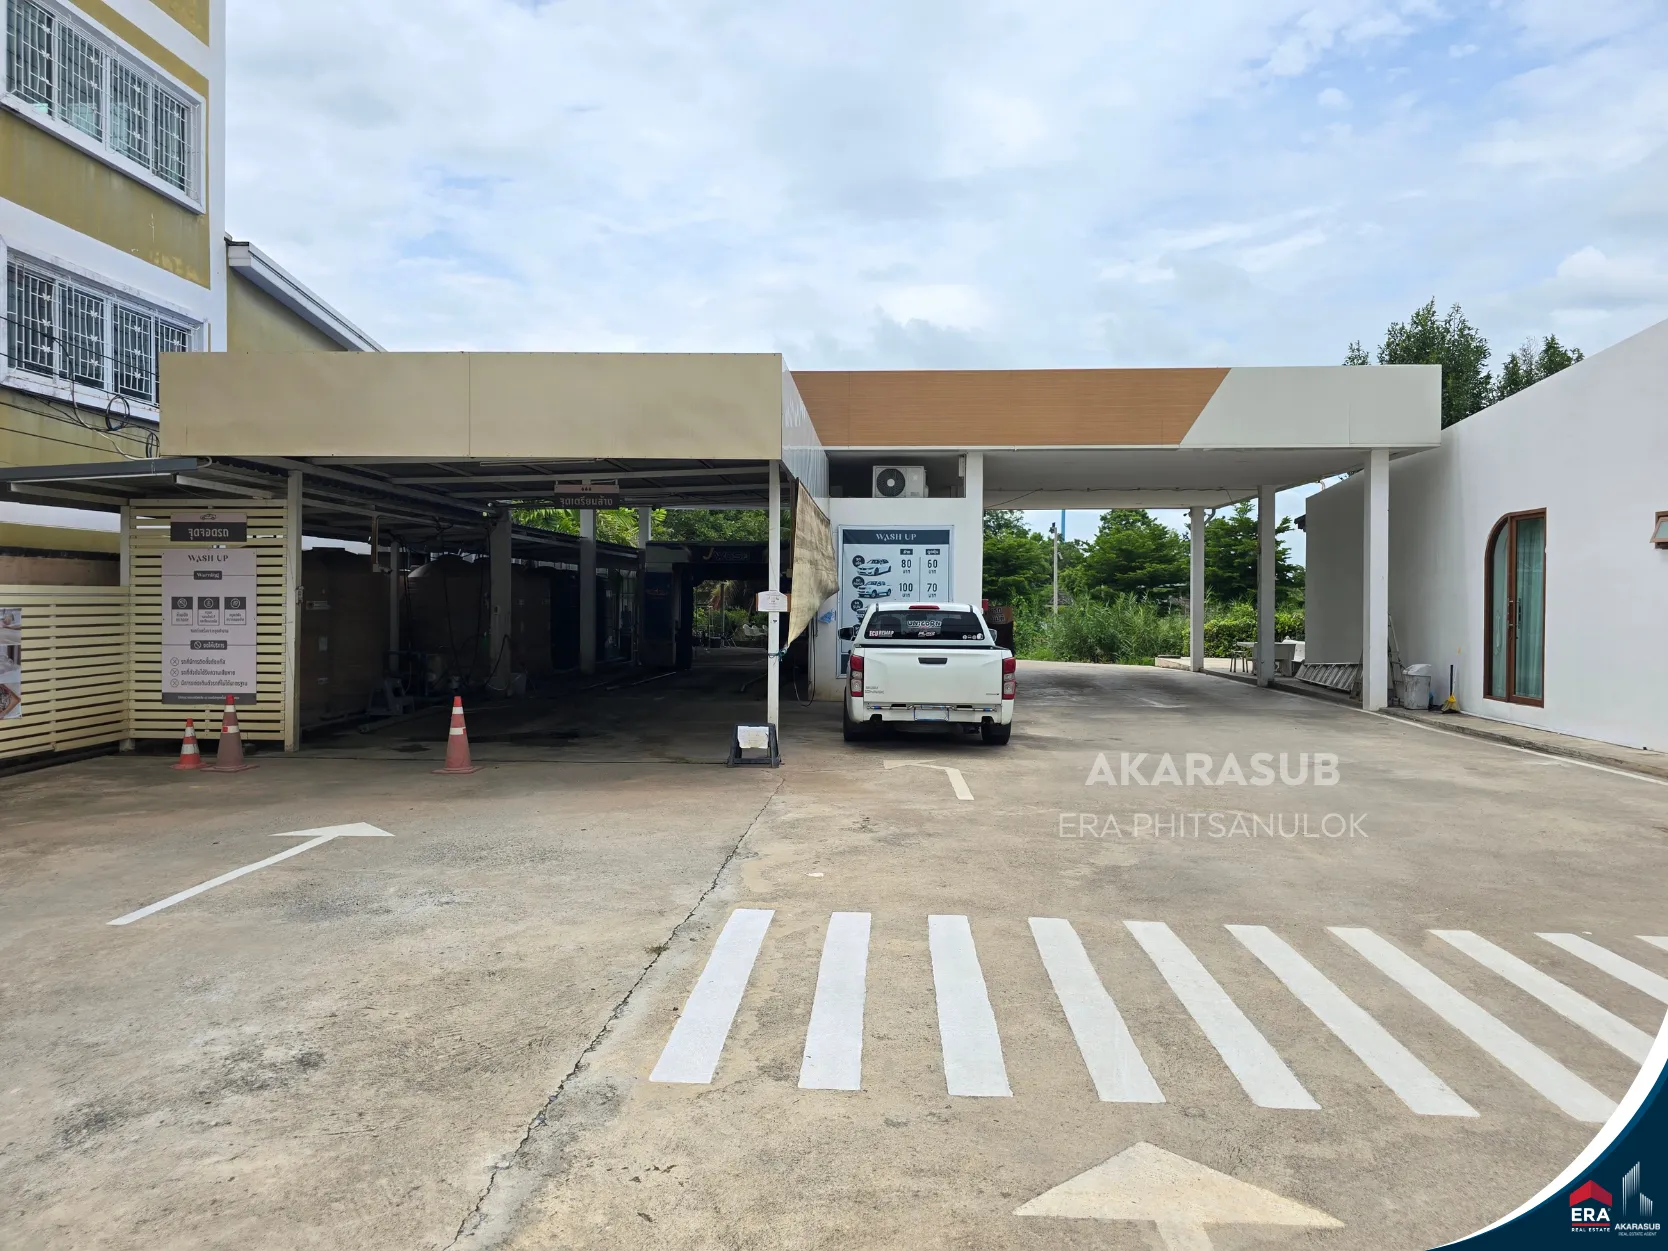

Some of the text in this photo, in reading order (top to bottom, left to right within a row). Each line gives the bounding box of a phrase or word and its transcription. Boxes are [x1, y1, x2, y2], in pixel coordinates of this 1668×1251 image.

[187, 528, 229, 541] จุดจอดรถ
[876, 533, 902, 541] WASH
[187, 554, 229, 563] WASH UP
[901, 559, 912, 569] 80
[927, 559, 938, 569] 60
[899, 582, 914, 592] 100
[926, 582, 938, 592] 70
[906, 619, 943, 629] UNICORN
